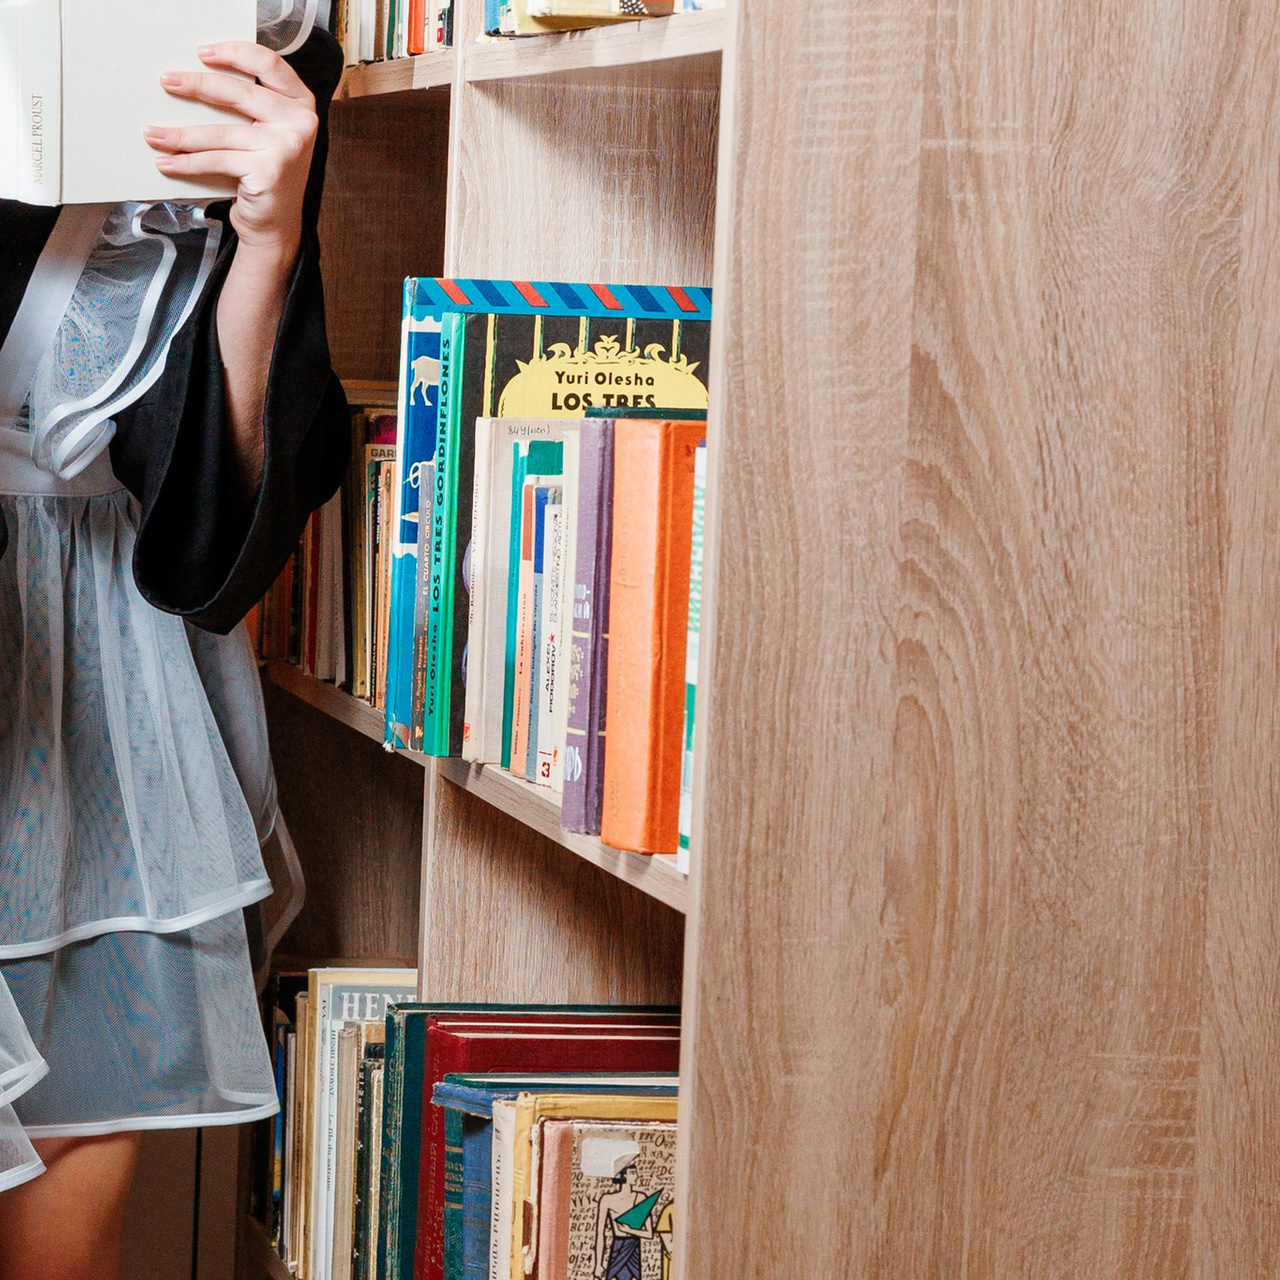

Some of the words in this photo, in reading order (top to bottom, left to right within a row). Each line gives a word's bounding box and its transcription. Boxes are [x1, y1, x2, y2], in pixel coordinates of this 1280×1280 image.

[31, 93, 44, 137] PROUST
[31, 139, 44, 186] MARCEL
[554, 370, 589, 385] Yuri
[593, 371, 656, 387] Olesha
[551, 392, 594, 411] LOS
[602, 393, 657, 409] TRES
[437, 338, 450, 506] GORDINFLONES
[435, 515, 444, 565] TRES
[423, 543, 431, 582] CUARTO
[432, 574, 442, 613] LOS
[429, 624, 439, 681] Olesha
[548, 644, 557, 714] FIODOROV
[427, 685, 436, 717] Yuri
[540, 762, 552, 779] 3
[329, 1029, 338, 1061] HENRI
[329, 1062, 337, 1098] TROYAT
